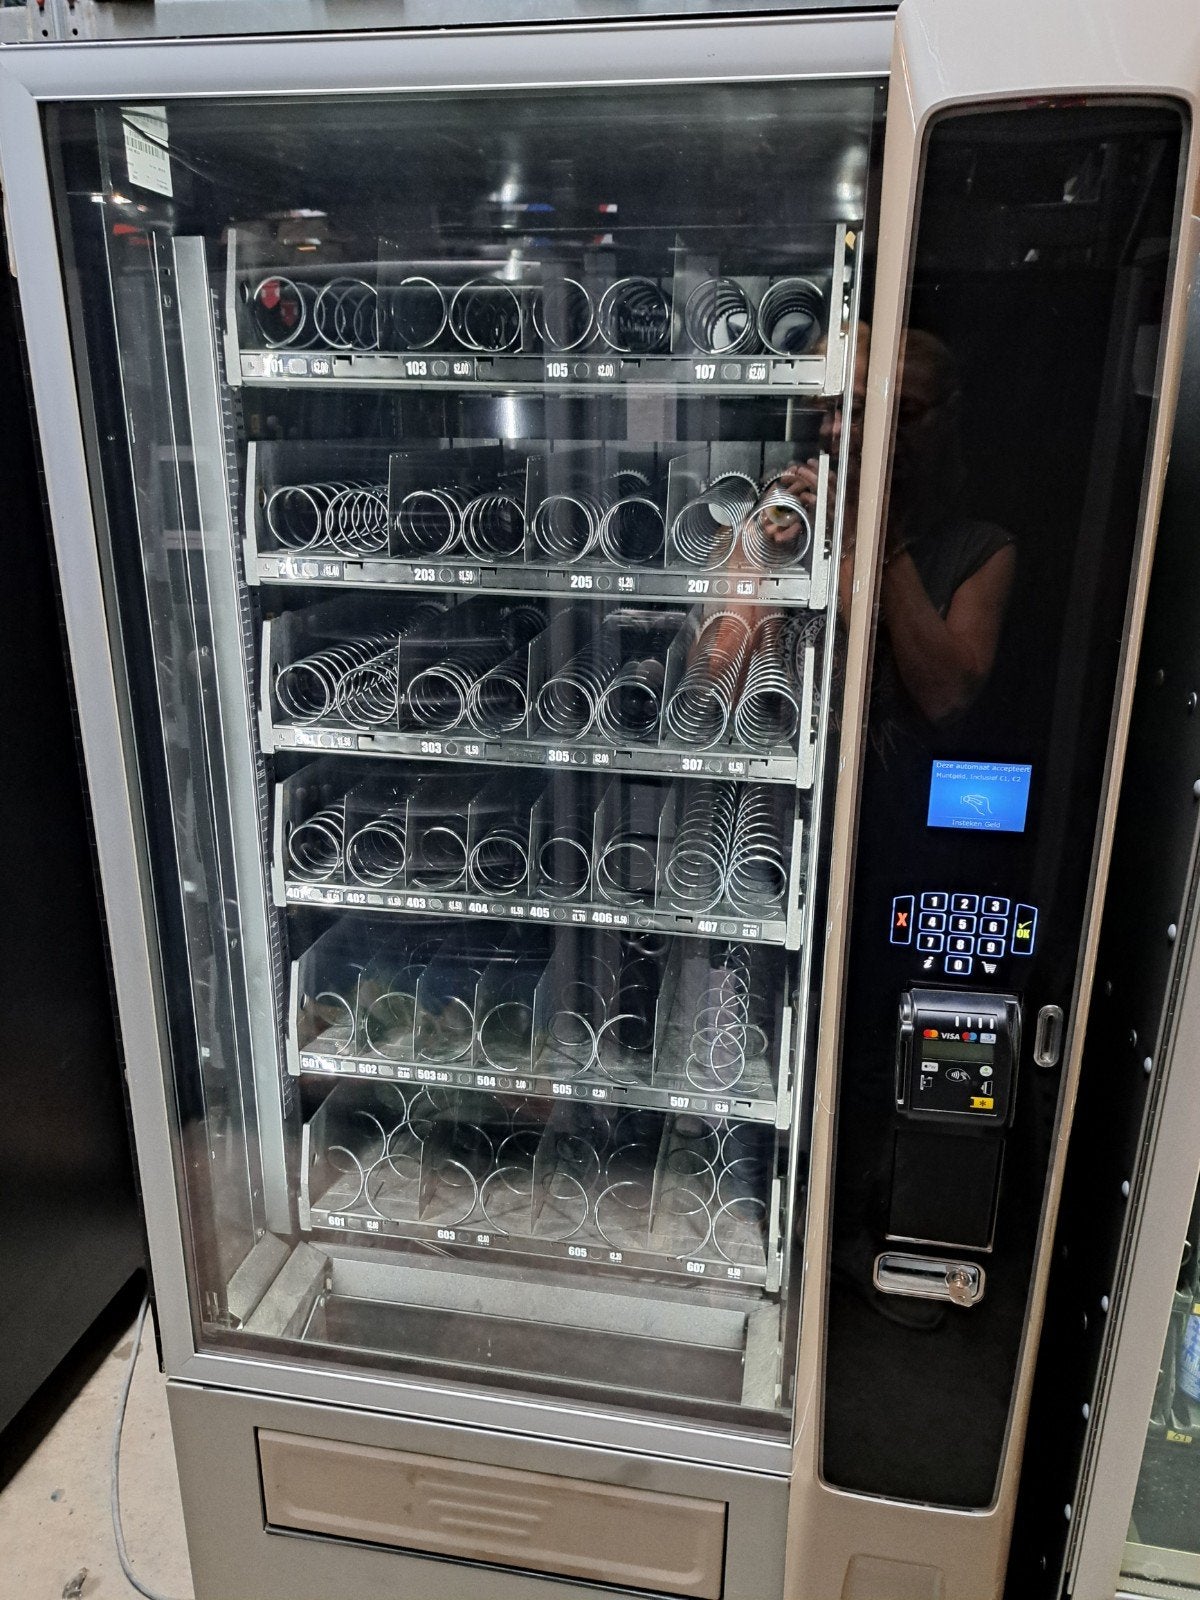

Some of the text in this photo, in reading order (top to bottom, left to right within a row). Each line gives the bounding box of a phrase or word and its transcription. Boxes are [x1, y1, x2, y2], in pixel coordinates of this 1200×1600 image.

[405, 361, 427, 376] 103
[546, 363, 614, 378] 105 $2.00
[694, 364, 716, 380] 107
[414, 568, 435, 581] 203
[570, 575, 592, 589] 205
[687, 579, 710, 593] 207
[421, 741, 442, 754] 303
[548, 750, 570, 762] 305
[682, 758, 703, 771] 307
[956, 763, 990, 771] automaat
[992, 765, 1031, 773] accepteert
[346, 893, 366, 904] 402
[406, 897, 426, 909] 403
[931, 896, 1000, 912] 1 2 3
[468, 902, 489, 914] 404
[529, 906, 550, 919] 405
[592, 911, 613, 924] 406
[697, 920, 718, 933] 407
[928, 916, 998, 932] 4 5 6
[1016, 929, 1030, 939] OK
[927, 936, 996, 953] 7 8 9
[954, 959, 963, 970] 0
[941, 1032, 960, 1040] VISA
[358, 1063, 378, 1075] 502
[417, 1069, 436, 1081] 503
[477, 1075, 496, 1087] 504
[552, 1083, 572, 1095] 505
[670, 1096, 689, 1108] 507
[328, 1215, 345, 1227] 601
[437, 1229, 455, 1240] 603
[568, 1246, 587, 1258] 605
[686, 1261, 705, 1273] 607
